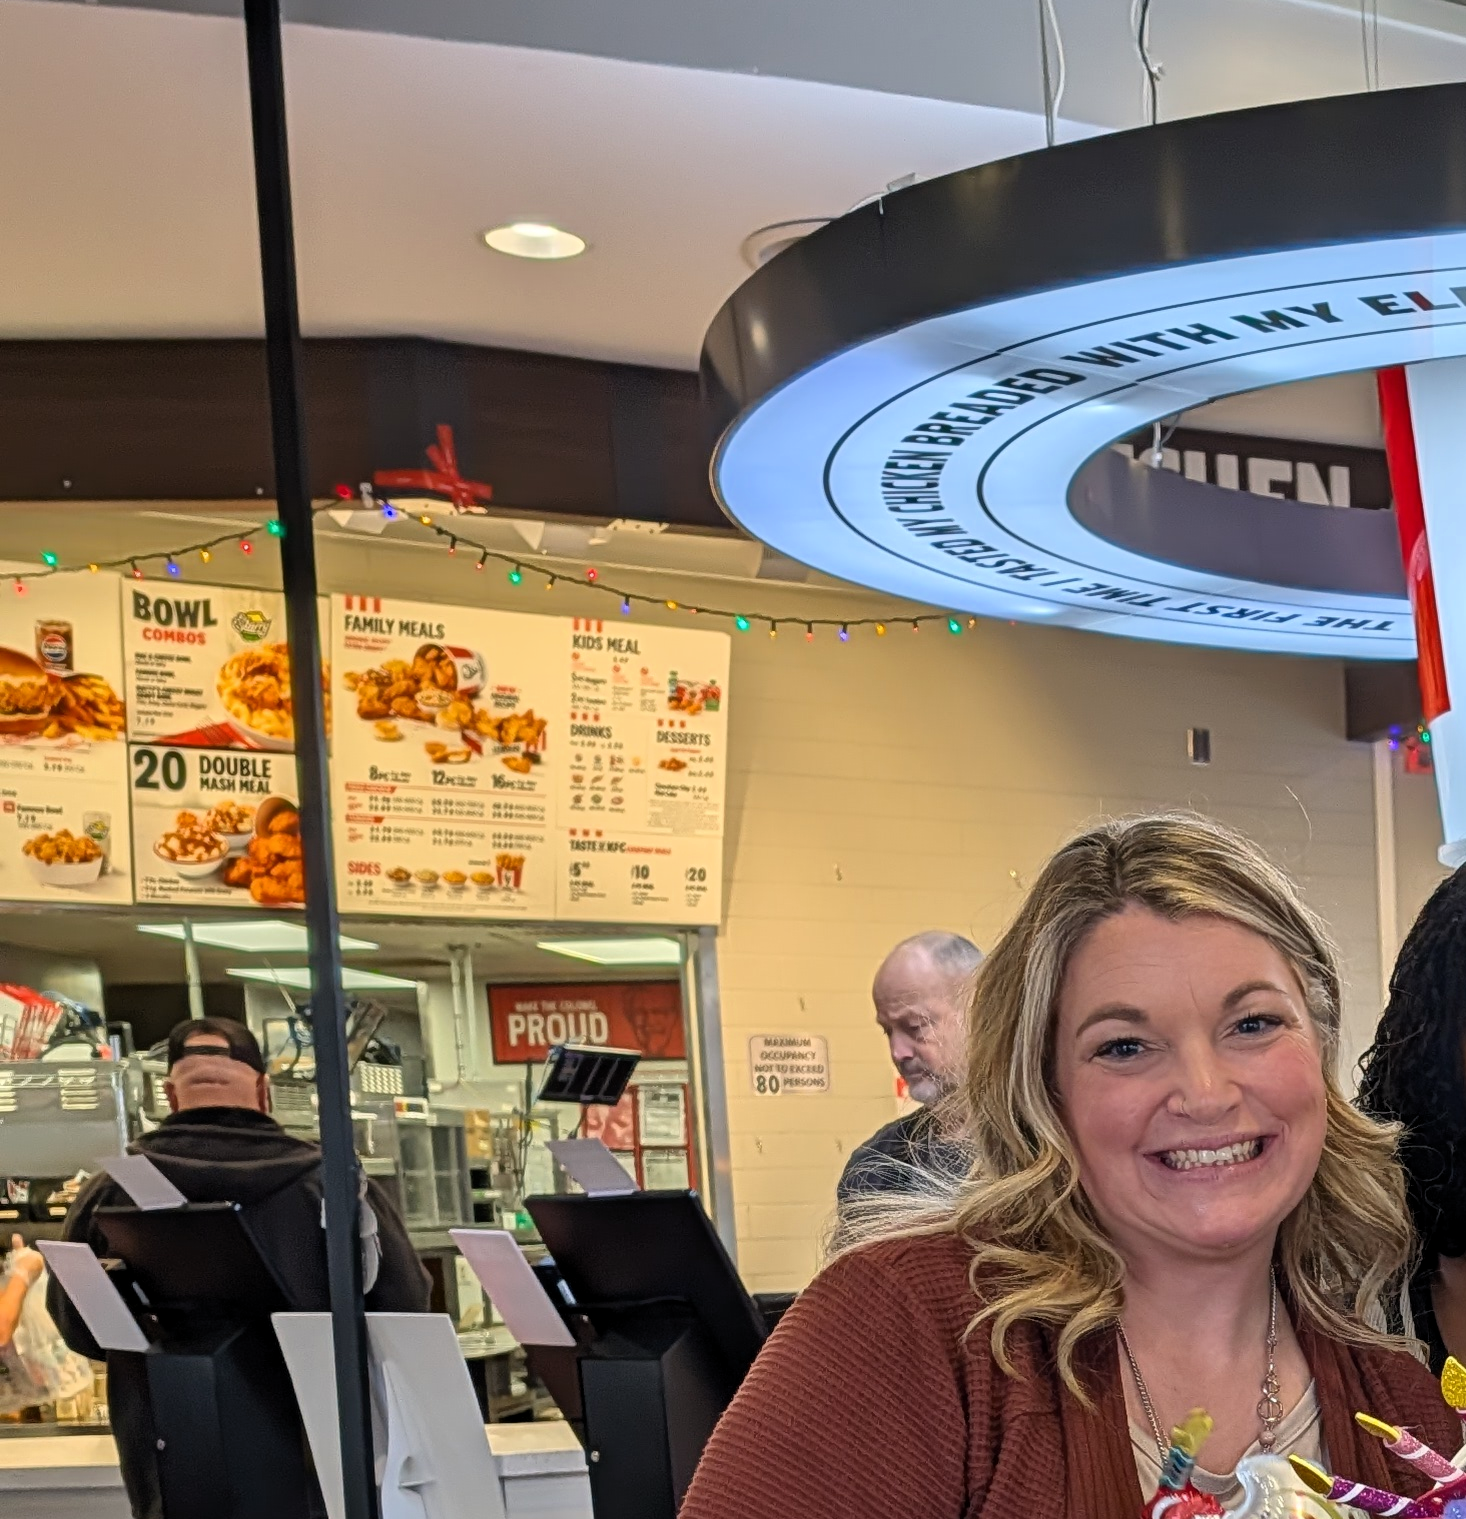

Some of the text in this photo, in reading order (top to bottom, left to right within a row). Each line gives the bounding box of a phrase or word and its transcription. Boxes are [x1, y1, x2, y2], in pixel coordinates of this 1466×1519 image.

[1229, 301, 1343, 333] MY
[1060, 322, 1236, 368] WITH
[901, 368, 1088, 447] BREADED
[881, 450, 953, 513] CHICKEN
[896, 518, 969, 537] MY
[930, 538, 1040, 580] TASTED
[1067, 580, 1172, 610] TIME
[132, 589, 218, 628] BOWL
[1173, 601, 1293, 625] FIRST
[344, 614, 445, 639] FAMILY MEALS
[1301, 613, 1397, 633] THE
[142, 627, 206, 645] COMBOS
[572, 634, 641, 655] KIDS MEAL
[570, 724, 613, 739] DRINKS
[656, 730, 711, 746] DESSERTS
[134, 748, 272, 791] 20 DOUBLE
[199, 777, 273, 794] MASH MEAL
[570, 840, 597, 852] TASTE
[607, 842, 627, 853] KFC
[347, 861, 381, 876] SIDES
[508, 1011, 608, 1047] PROUD
[764, 1037, 811, 1047] MAXIMUM
[760, 1051, 816, 1060] OCCUPANCY
[755, 1064, 773, 1072] NOT
[789, 1064, 825, 1073] EXCEED
[756, 1075, 825, 1094] 80 PERSONS
